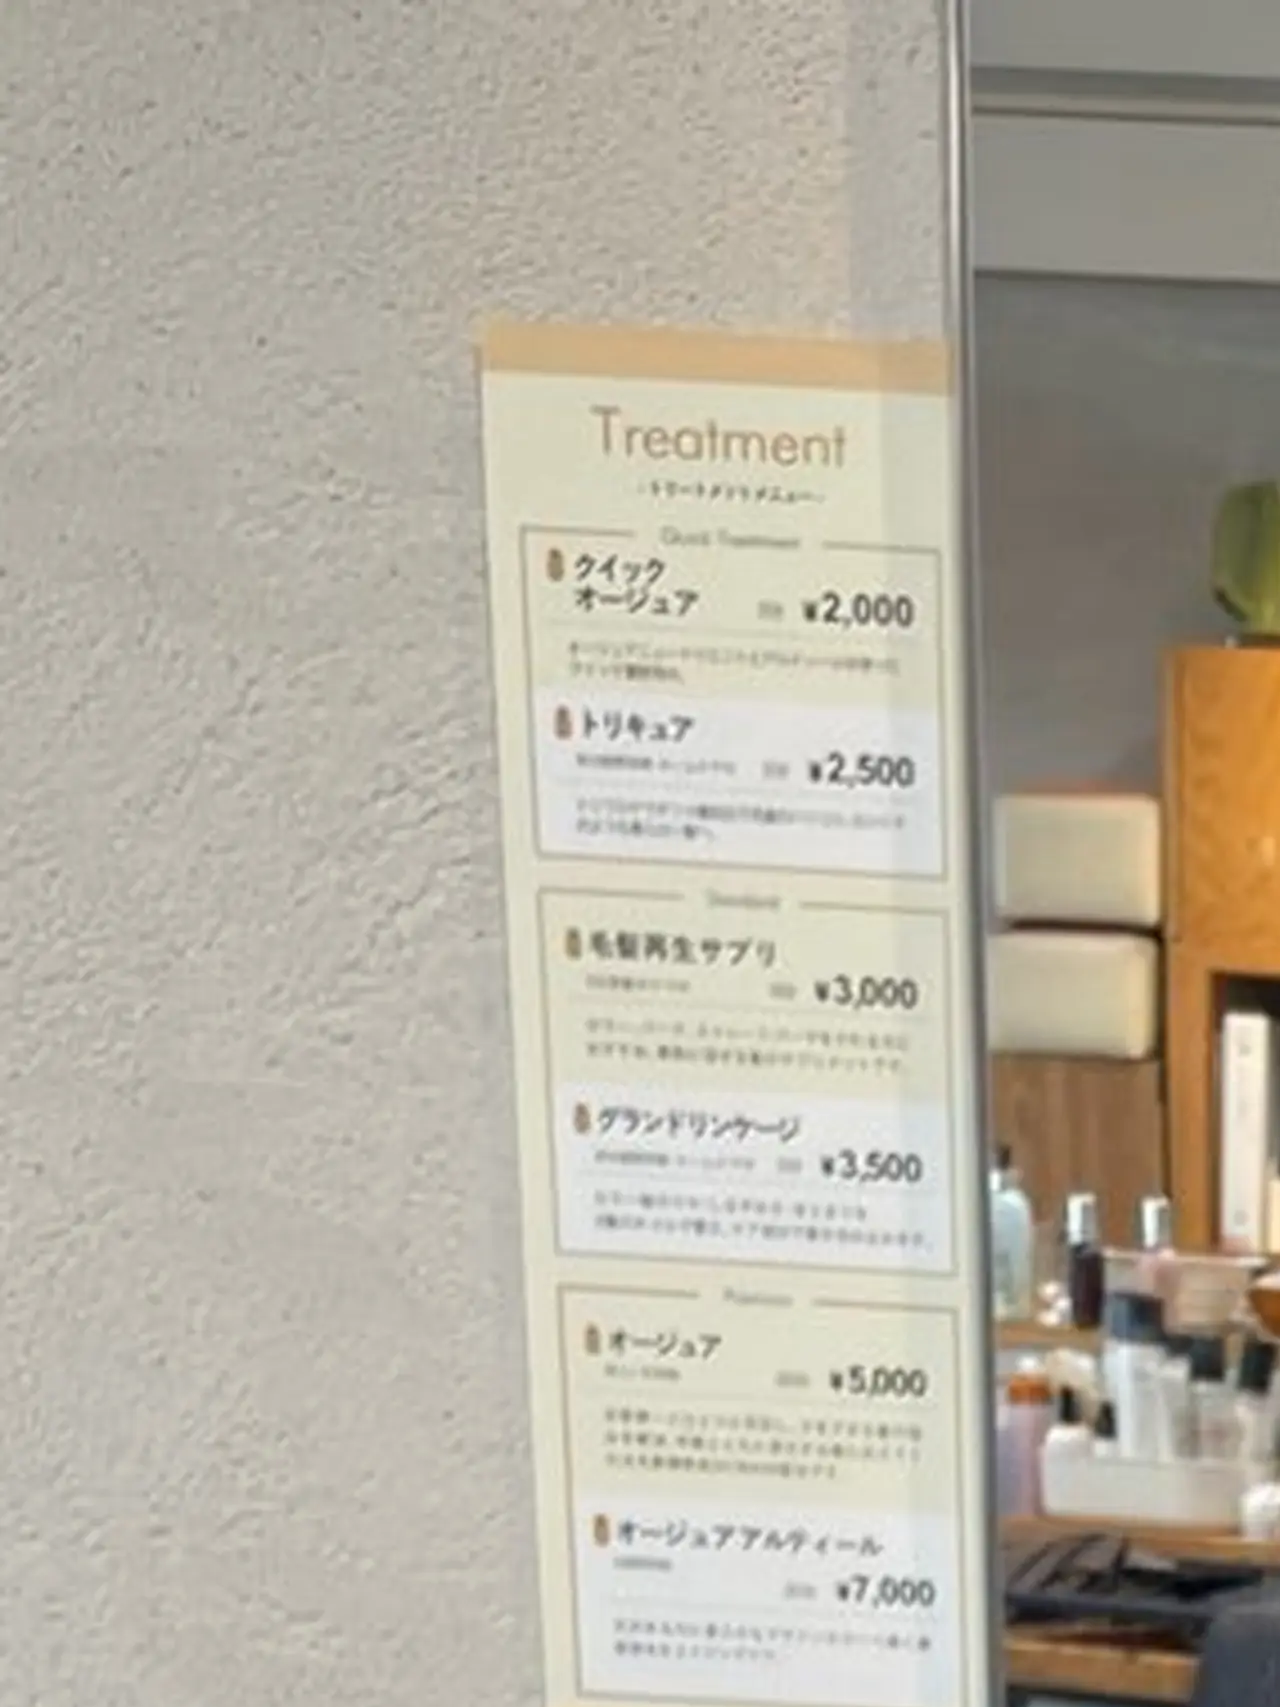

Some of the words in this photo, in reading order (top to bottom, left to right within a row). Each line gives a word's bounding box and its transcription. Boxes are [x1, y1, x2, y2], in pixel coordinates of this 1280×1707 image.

[588, 405, 848, 468] Treatment
[574, 554, 666, 584] クイック
[575, 586, 699, 617] オージュア
[801, 590, 914, 628] ¥2,000
[582, 706, 695, 742] トリキュア
[808, 742, 915, 787] ¥2,500
[813, 974, 919, 1011] ¥3,000
[819, 1149, 923, 1184] ¥3,500
[607, 1330, 722, 1360] オージュア
[827, 1364, 928, 1400] ¥5,000
[836, 1575, 936, 1609] ¥7,000
